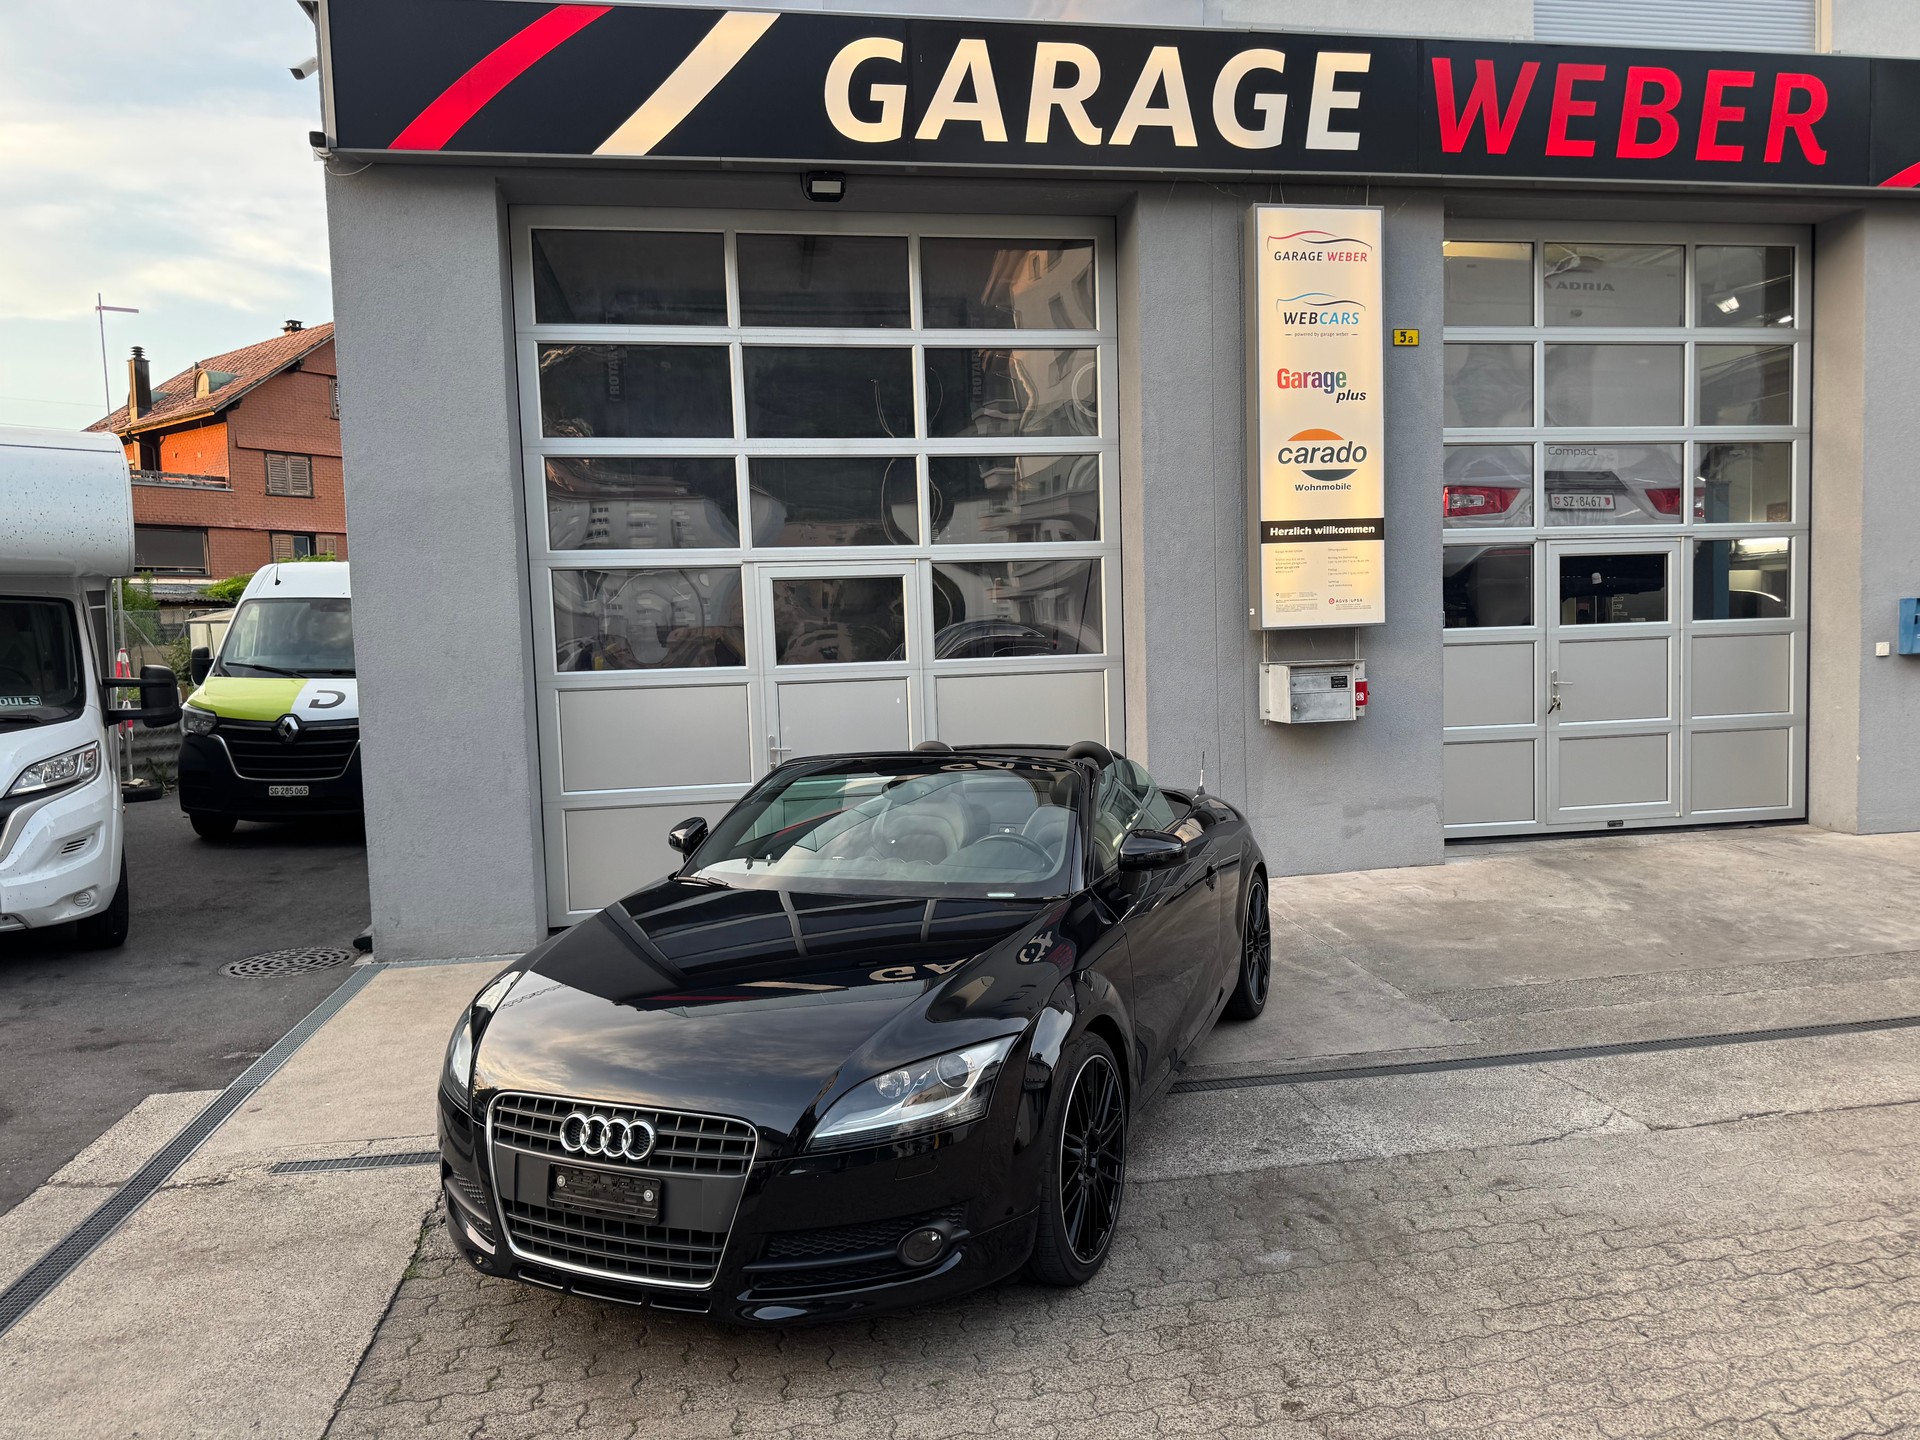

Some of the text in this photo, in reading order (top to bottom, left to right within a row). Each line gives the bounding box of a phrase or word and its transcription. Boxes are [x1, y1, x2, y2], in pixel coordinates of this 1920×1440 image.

[824, 37, 1828, 166] GARAGE WEBER
[1274, 251, 1367, 262] GARAGE WEBER
[1556, 281, 1615, 291] ADRIA
[1283, 312, 1359, 325] WEBCARS
[1276, 368, 1347, 394] Garage
[1336, 389, 1367, 403] plus
[1277, 441, 1367, 465] carado
[1548, 446, 1598, 457] Compact
[1295, 483, 1351, 491] Wohnmobile
[1270, 525, 1375, 536] Herzlich willkommen
